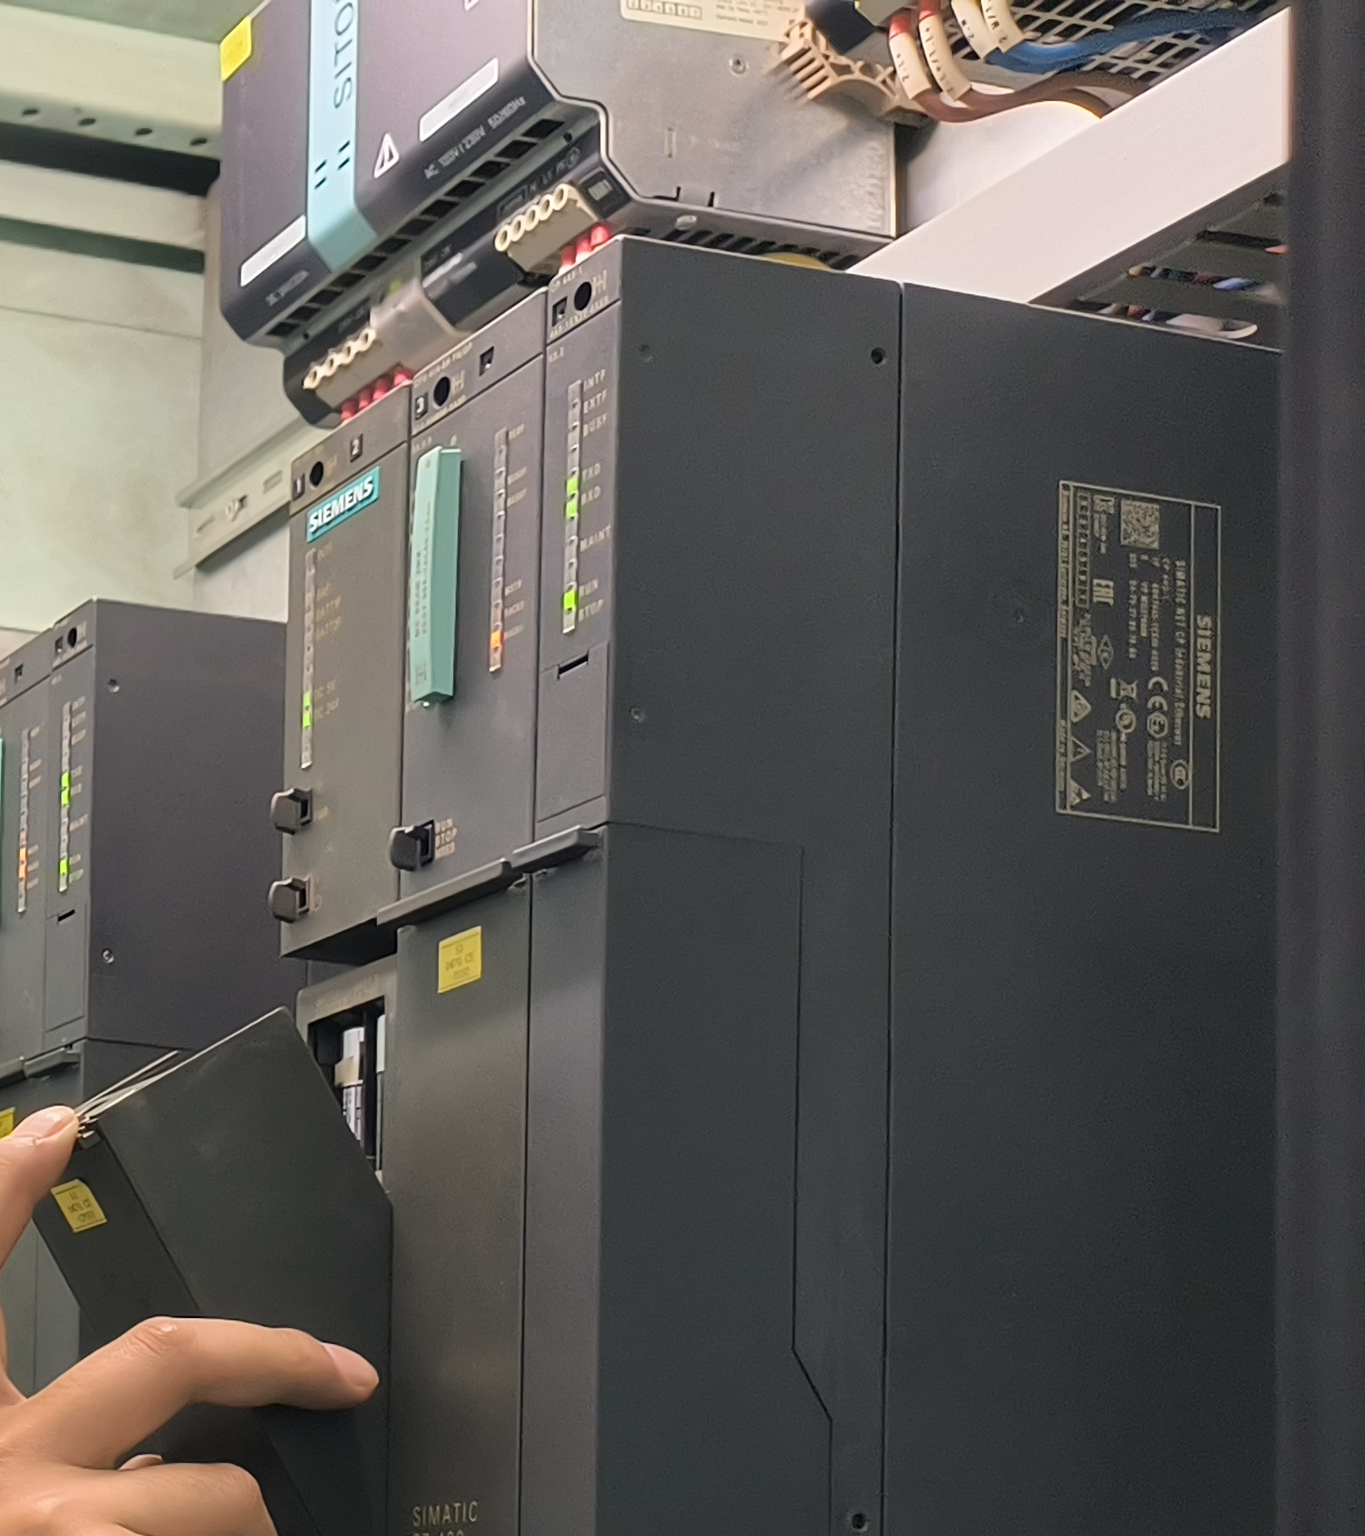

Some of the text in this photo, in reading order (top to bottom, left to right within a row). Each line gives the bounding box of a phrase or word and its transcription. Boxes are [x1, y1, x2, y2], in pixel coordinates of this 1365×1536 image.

[333, 0, 354, 109] SITO
[415, 394, 425, 417] 3
[583, 389, 608, 414] EXTF
[308, 474, 376, 534] SIEMENS
[1175, 560, 1188, 604] SIMATIC
[1195, 614, 1212, 719] SIEMENS
[435, 827, 457, 847] STOP
[412, 1501, 478, 1527] SIMATIC
